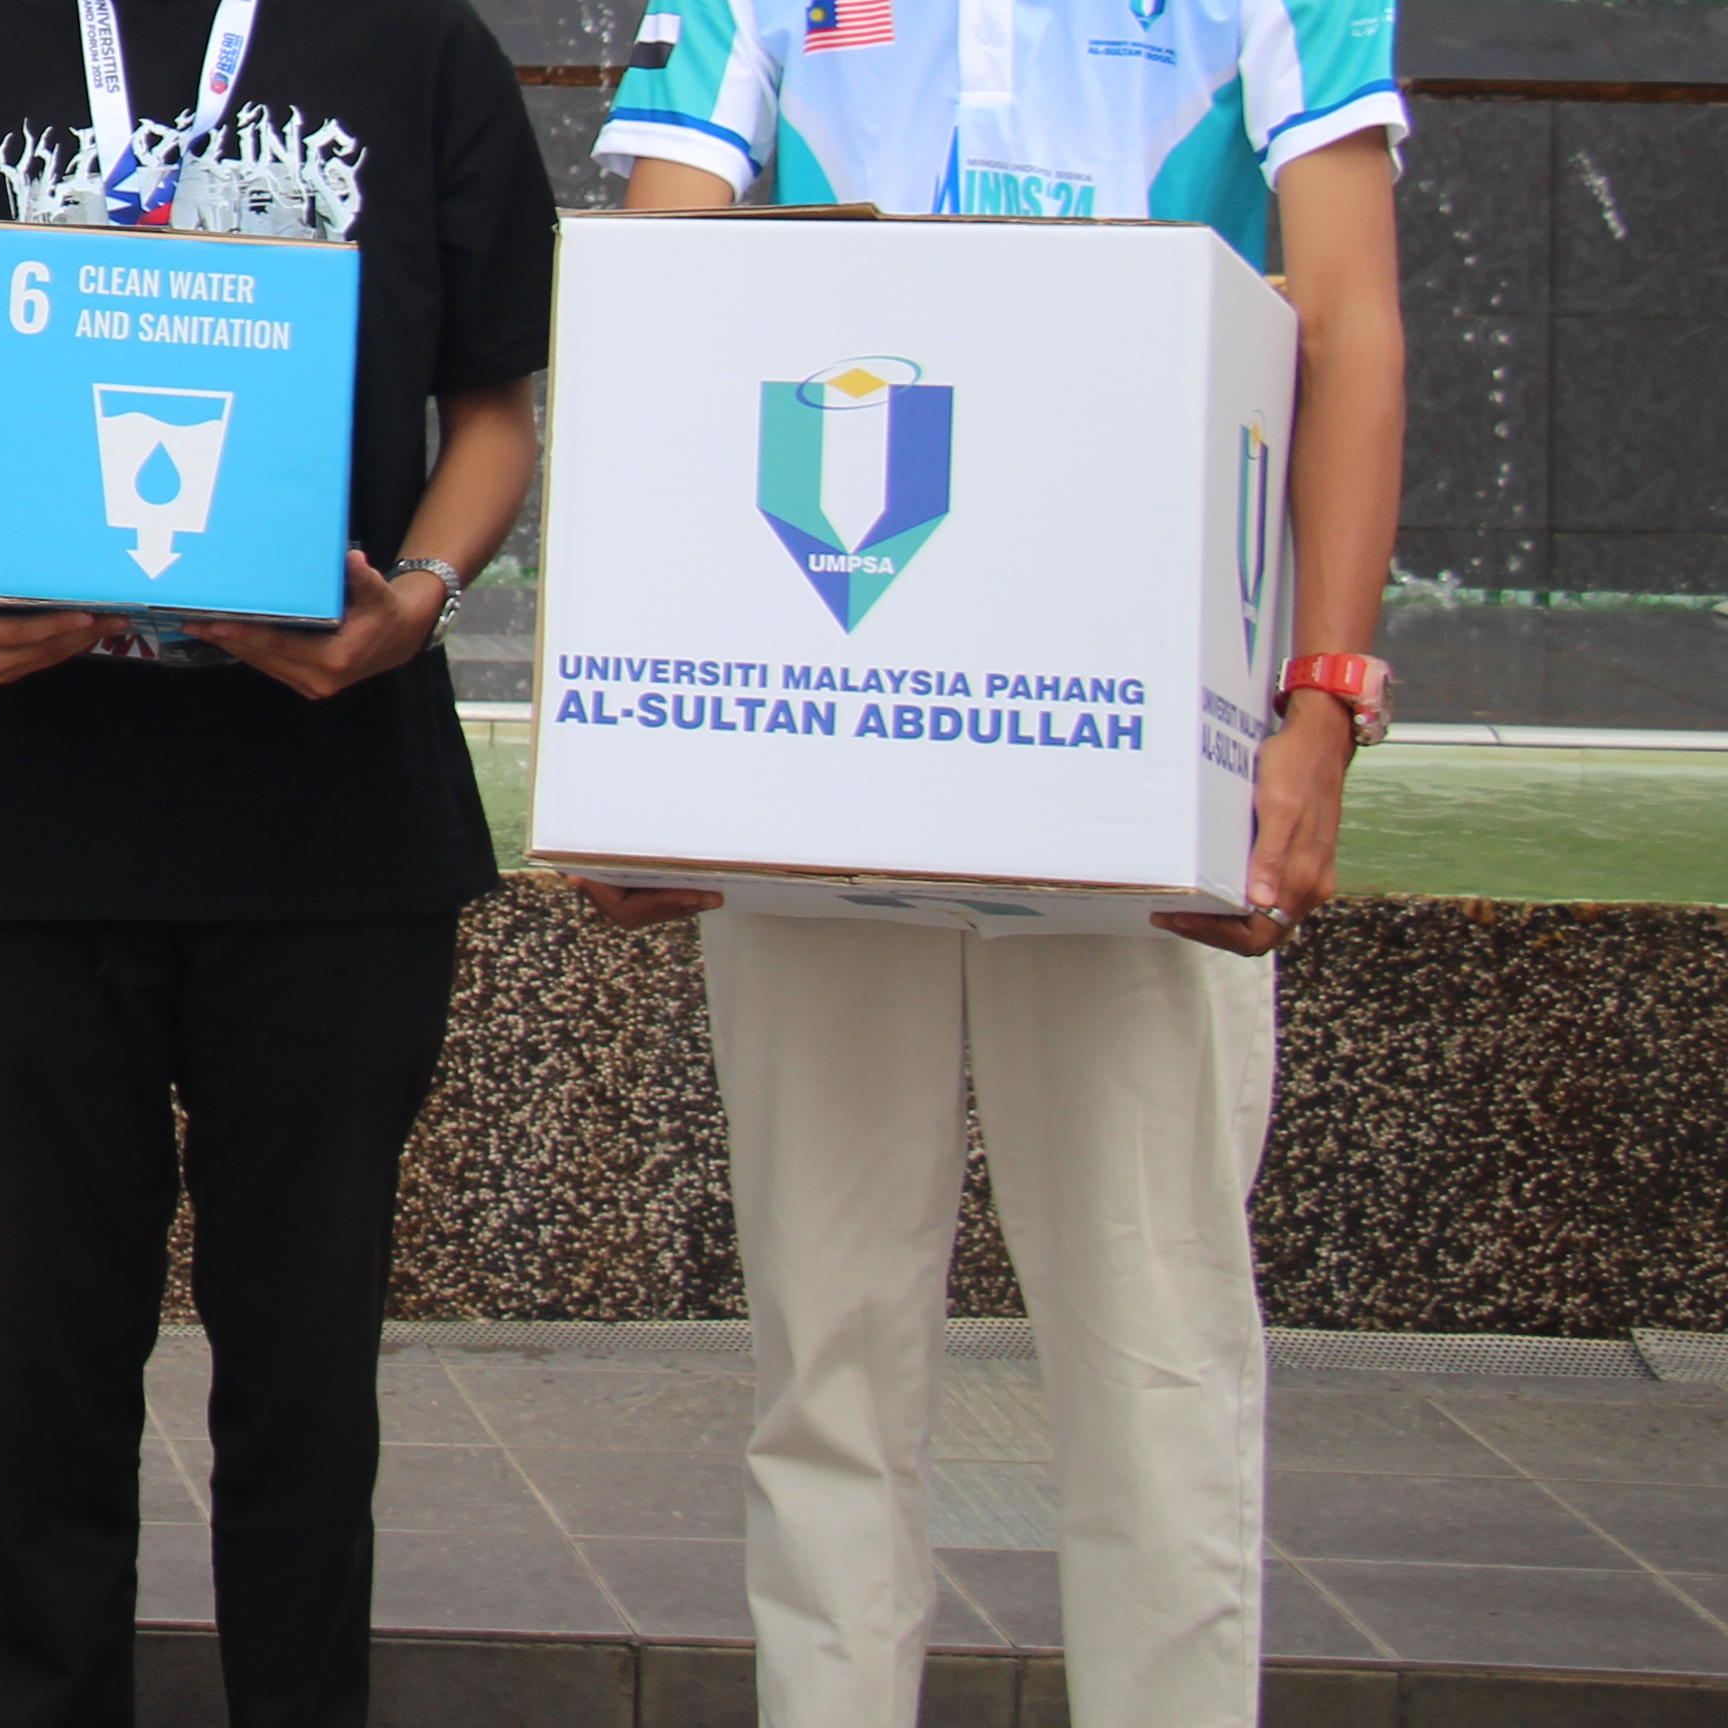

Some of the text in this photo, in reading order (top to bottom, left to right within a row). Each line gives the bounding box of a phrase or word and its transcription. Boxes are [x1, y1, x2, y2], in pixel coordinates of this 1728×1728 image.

[9, 260, 50, 335] 6
[78, 264, 255, 304] CLEAN WATER
[75, 309, 292, 350] AND SANITATION
[808, 553, 895, 575] UMPSA
[558, 654, 1146, 705] UNIVERSITI MALAYSIA PAHANG
[554, 689, 1143, 751] AL-SULTAN ABDULLAH
